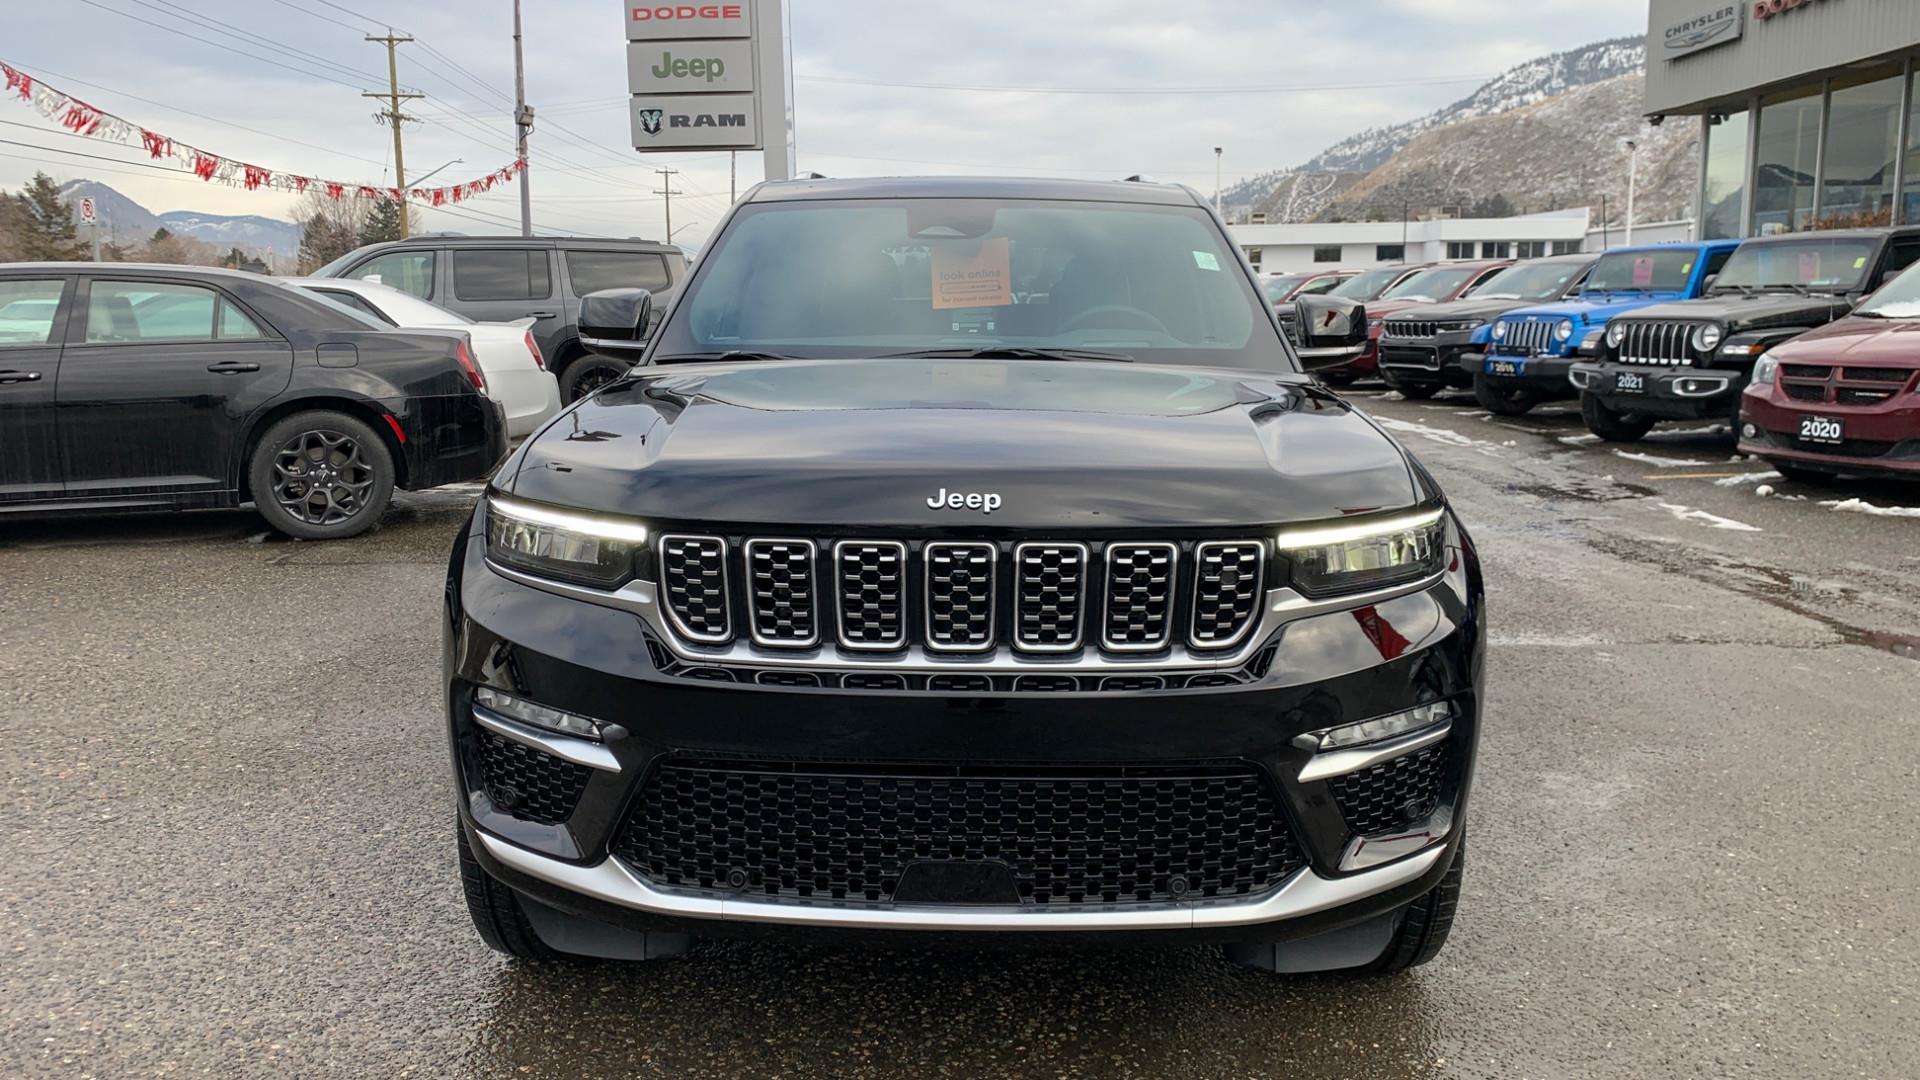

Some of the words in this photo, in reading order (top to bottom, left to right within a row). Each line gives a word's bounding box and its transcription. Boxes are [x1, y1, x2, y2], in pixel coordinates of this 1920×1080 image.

[632, 6, 741, 21] DODGE
[1665, 7, 1734, 38] CHRYSLER
[652, 52, 725, 82] Jeep
[670, 114, 746, 127] RAM
[941, 271, 964, 281] look
[967, 269, 1000, 280] online
[1618, 375, 1643, 389] 2021
[1801, 420, 1840, 438] 2020
[926, 488, 1001, 513] Jeep
